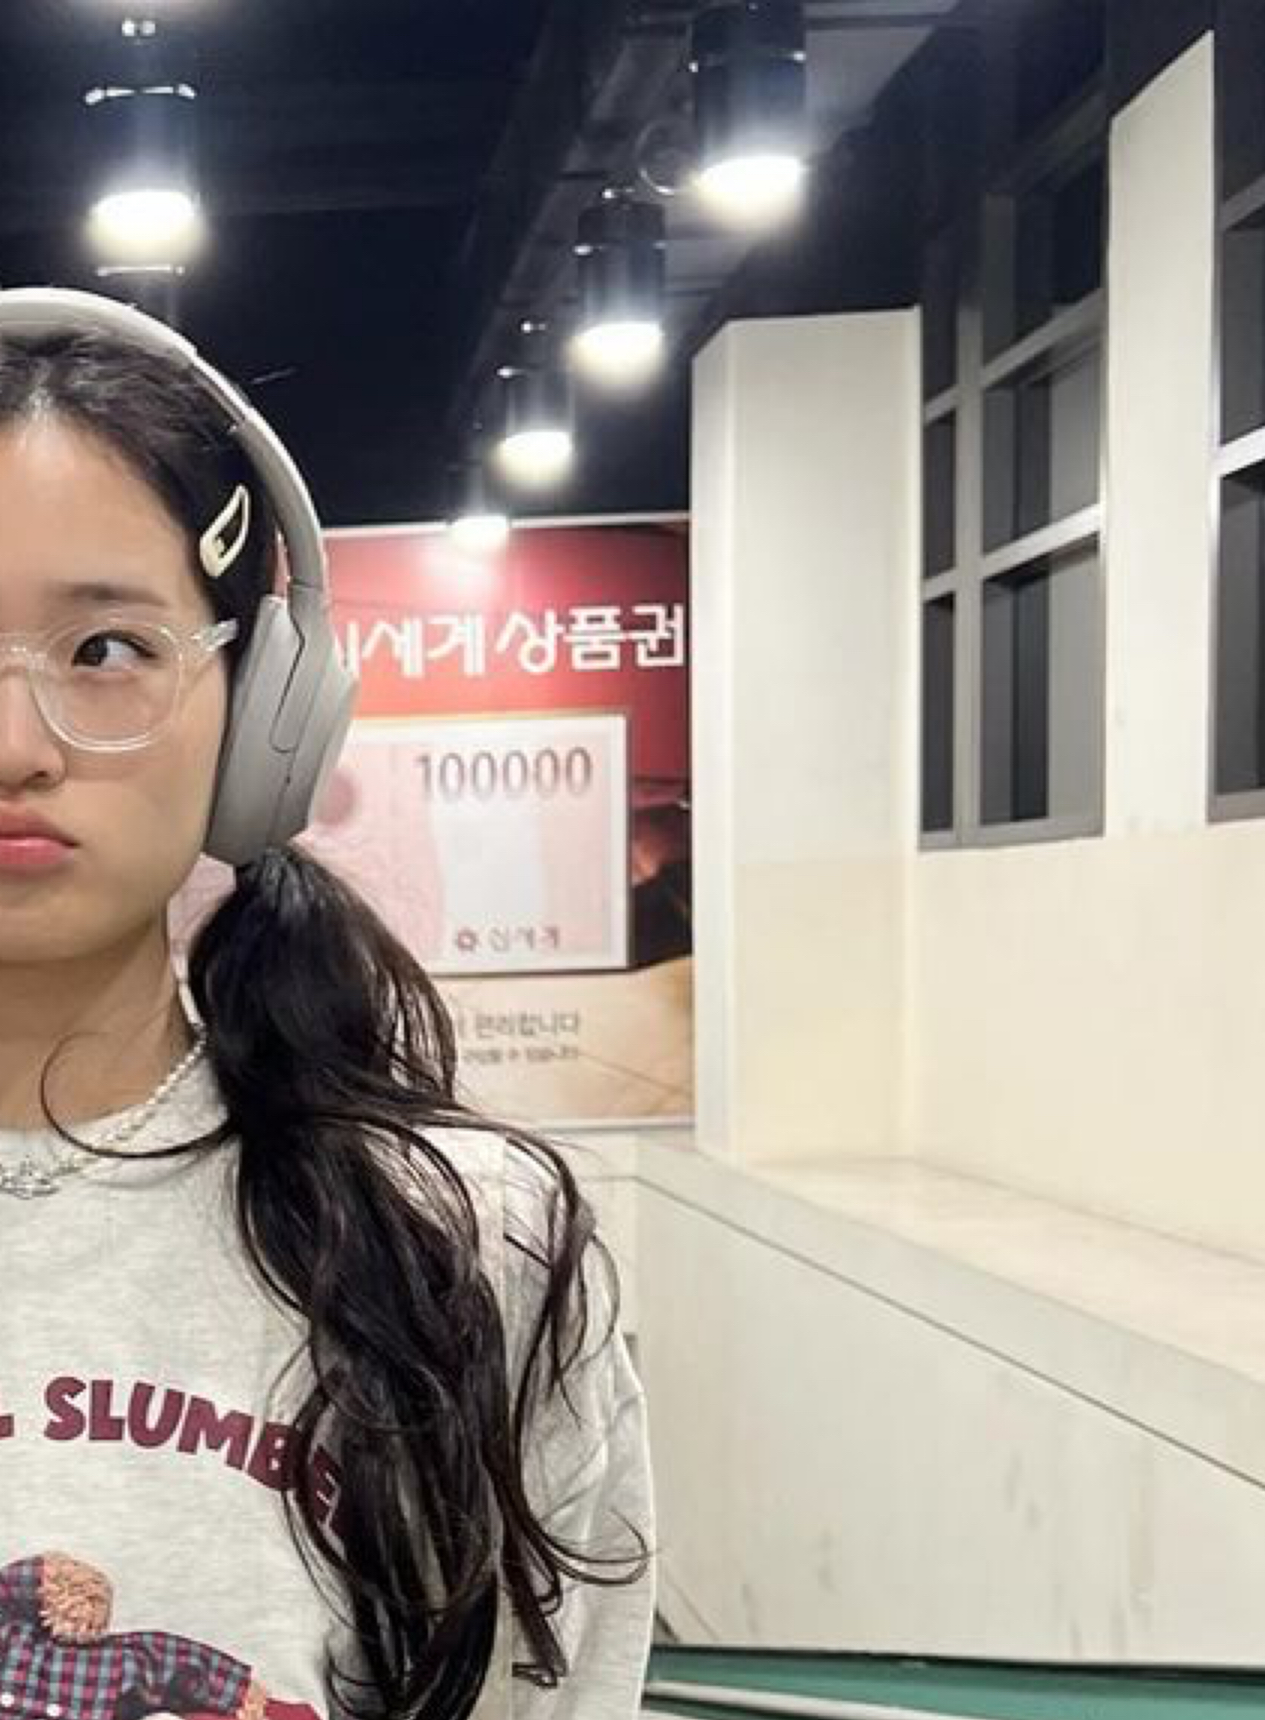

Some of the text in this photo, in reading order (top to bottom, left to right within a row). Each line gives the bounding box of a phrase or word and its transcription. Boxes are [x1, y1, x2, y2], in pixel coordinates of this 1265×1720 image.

[495, 604, 685, 674] 상품권
[416, 747, 592, 798] 100000
[43, 1376, 355, 1536] SLUMBE
